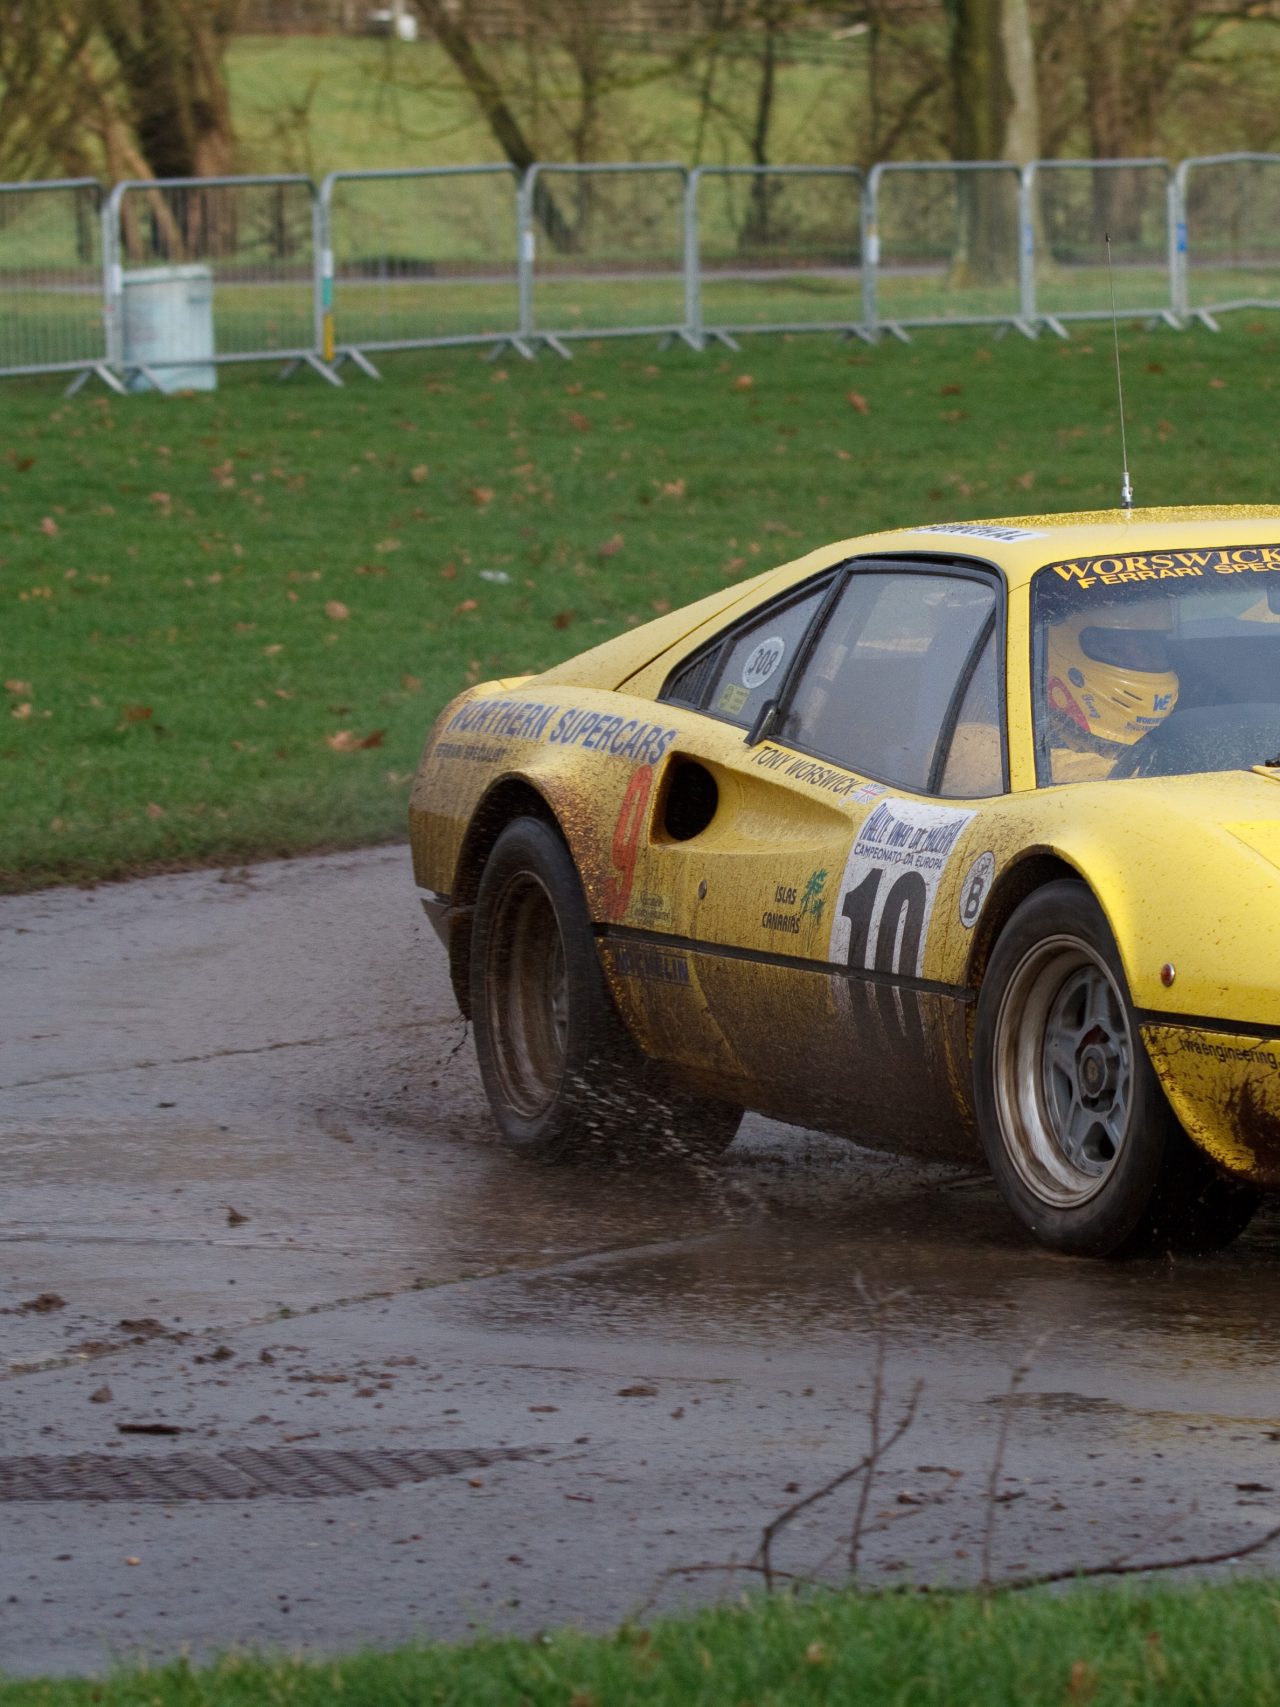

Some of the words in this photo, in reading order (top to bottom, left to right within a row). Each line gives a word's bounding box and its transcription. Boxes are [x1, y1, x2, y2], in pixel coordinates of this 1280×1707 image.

[1077, 567, 1204, 589] FERRARI
[746, 648, 779, 676] 308
[446, 701, 559, 739] NORTHERN
[550, 708, 678, 765] SUPERCARS
[750, 745, 791, 770] TONY
[784, 759, 861, 797] WORSWICK
[853, 842, 903, 863] CAMPEONATO
[903, 853, 915, 866] DA
[914, 855, 943, 870] EUROPA
[775, 885, 797, 905] ISLAS
[963, 876, 984, 919] B
[761, 911, 801, 935] CANARIAS
[841, 867, 930, 1022] 10
